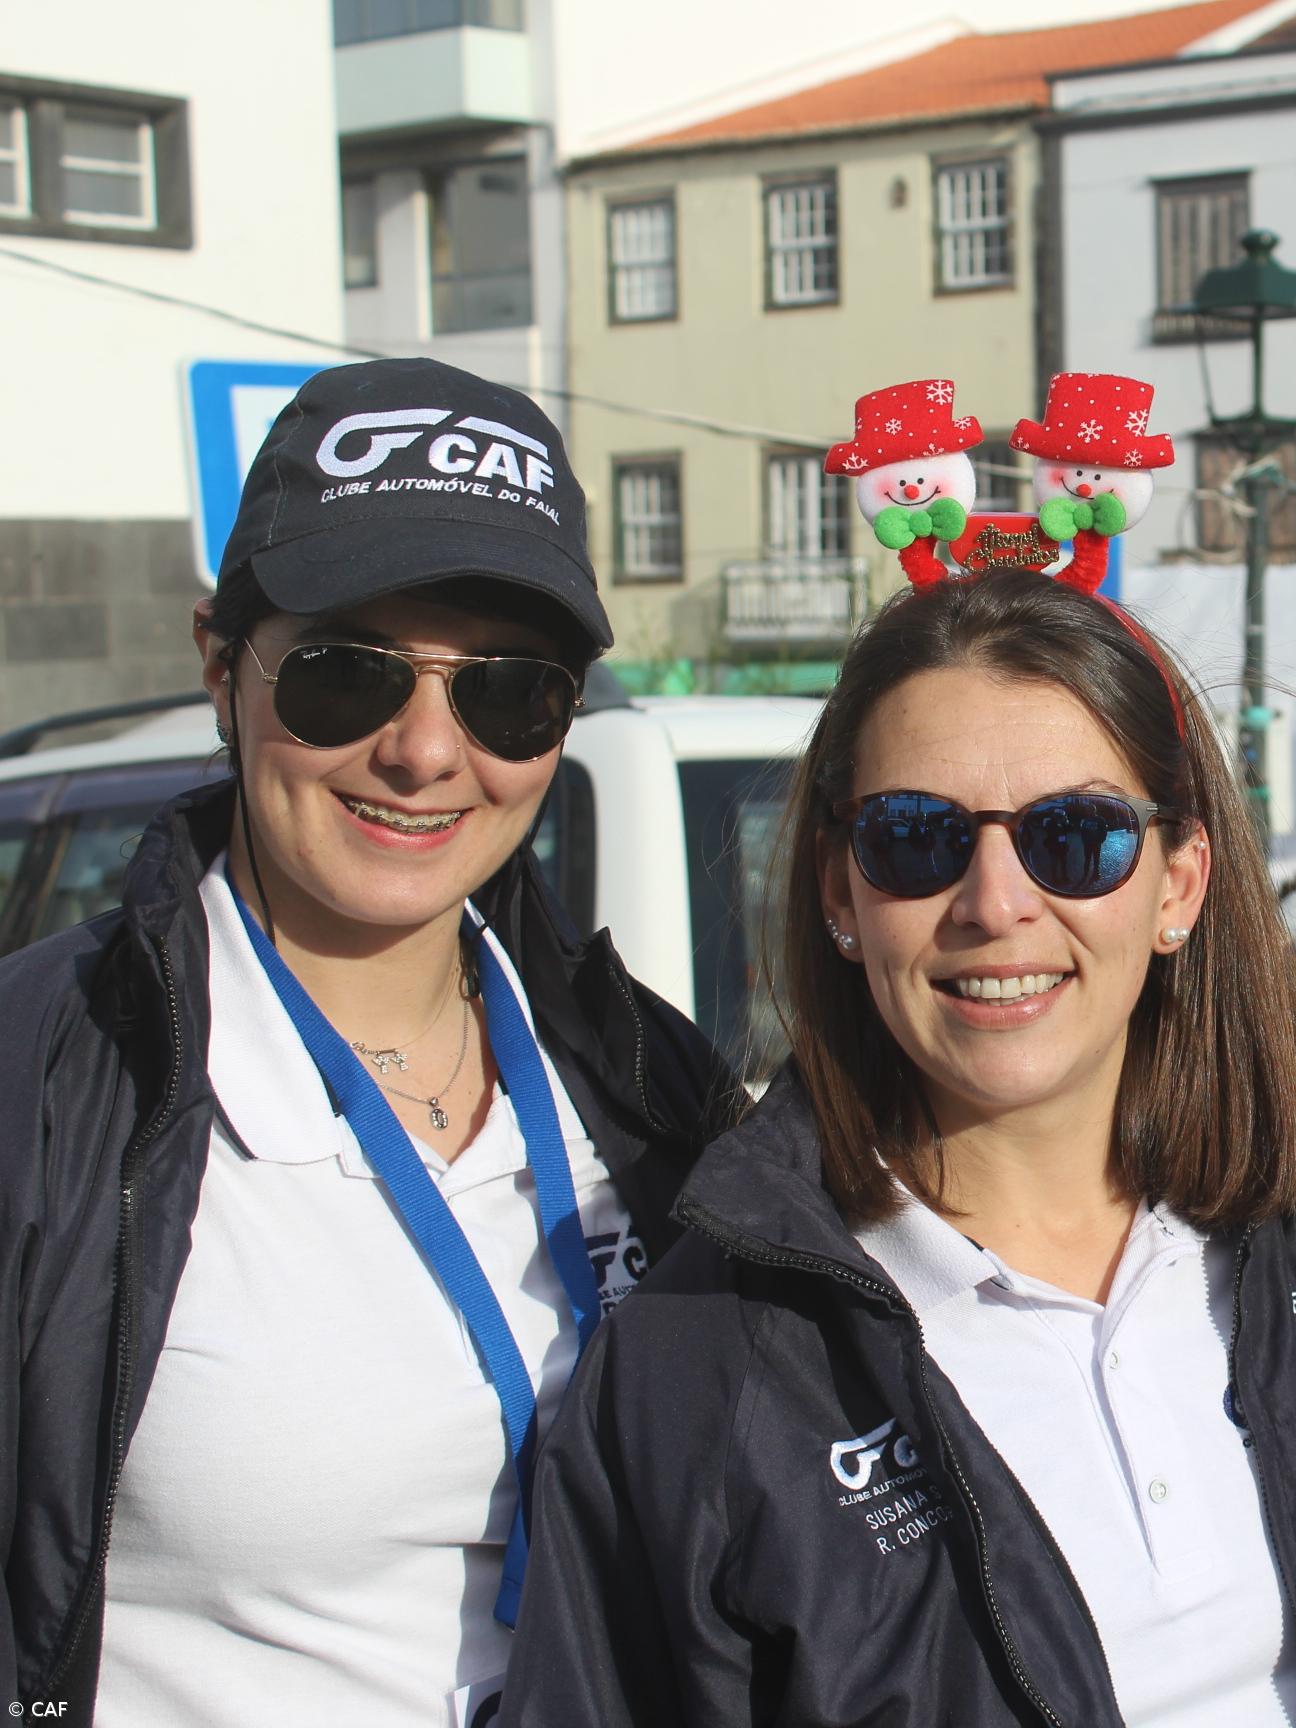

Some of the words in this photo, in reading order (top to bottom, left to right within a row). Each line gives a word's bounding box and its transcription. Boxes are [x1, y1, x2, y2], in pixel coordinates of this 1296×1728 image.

[428, 433, 554, 495] CAF
[320, 481, 372, 504] CLUBE
[375, 477, 493, 498] AUTOMÓVEL
[498, 488, 521, 503] DO
[525, 496, 560, 526] FAIAL
[838, 1490, 873, 1507] CLUBE
[866, 1489, 929, 1530] SUSANA
[876, 1536, 896, 1555] R.
